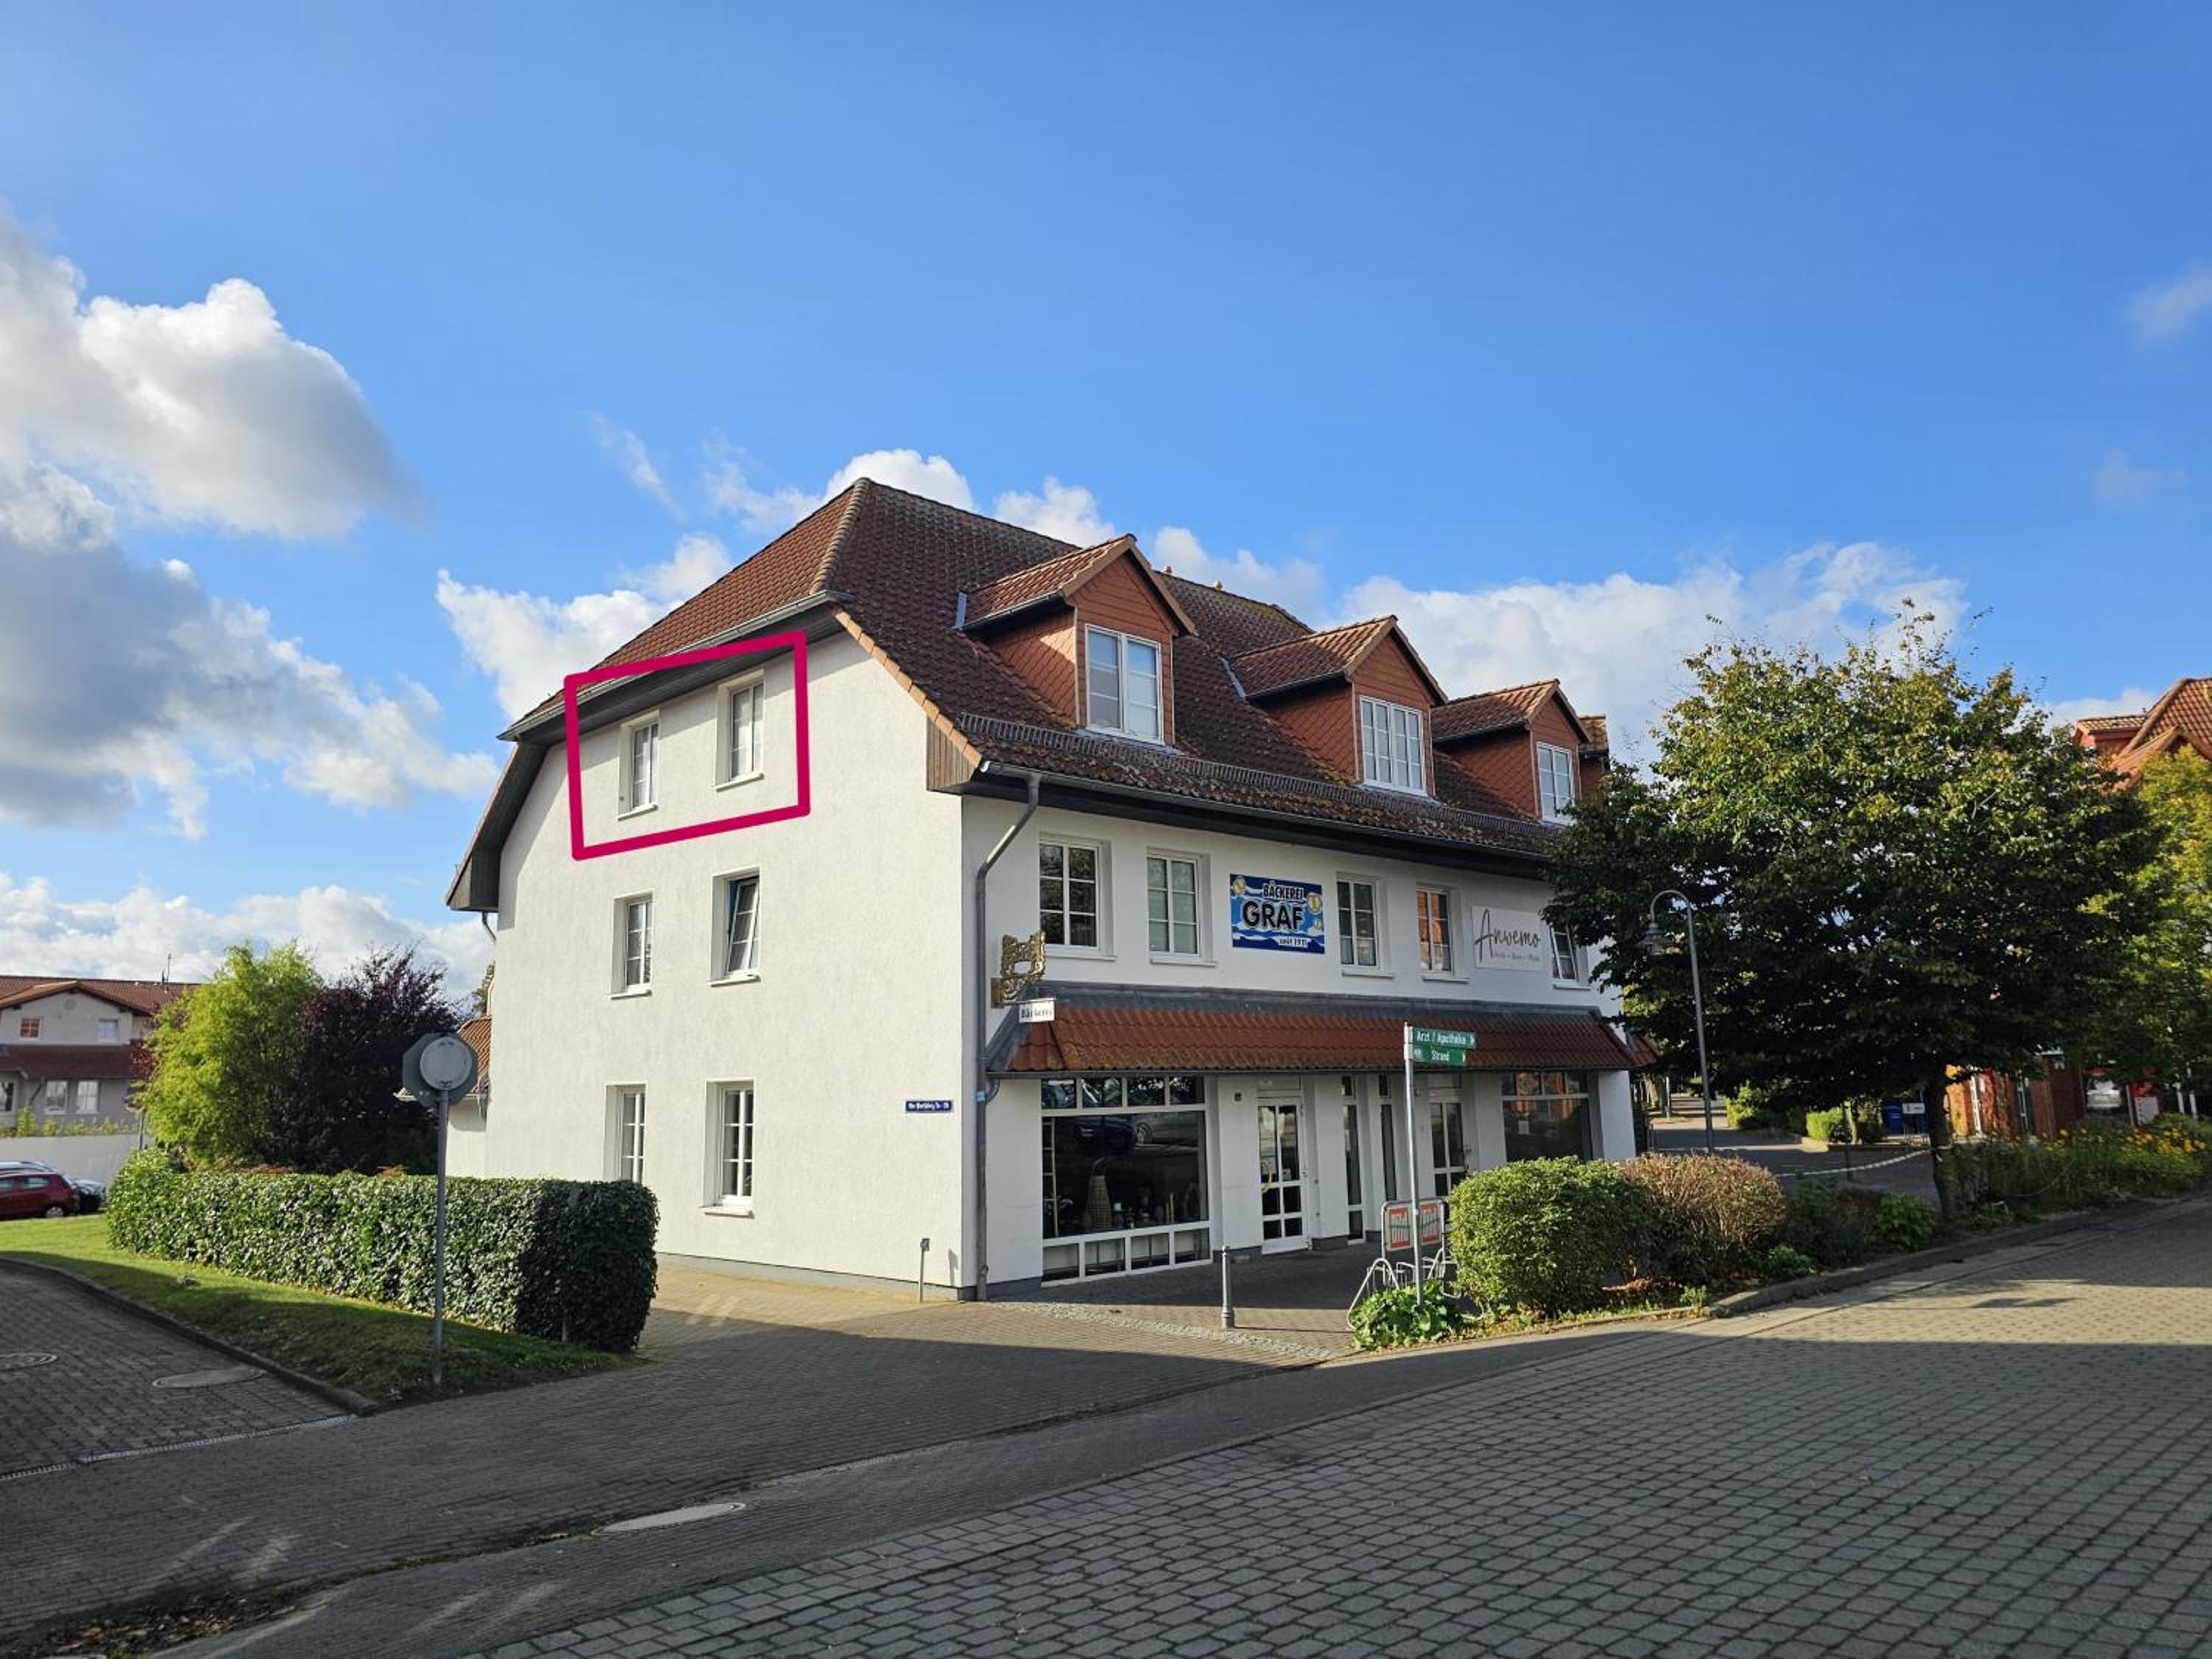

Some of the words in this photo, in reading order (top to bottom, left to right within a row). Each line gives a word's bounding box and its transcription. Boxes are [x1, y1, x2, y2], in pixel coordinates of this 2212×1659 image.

[1263, 882, 1304, 900] BÄCKEREI
[1243, 901, 1303, 929] GRAF
[1437, 1032, 1467, 1046] Apotheke
